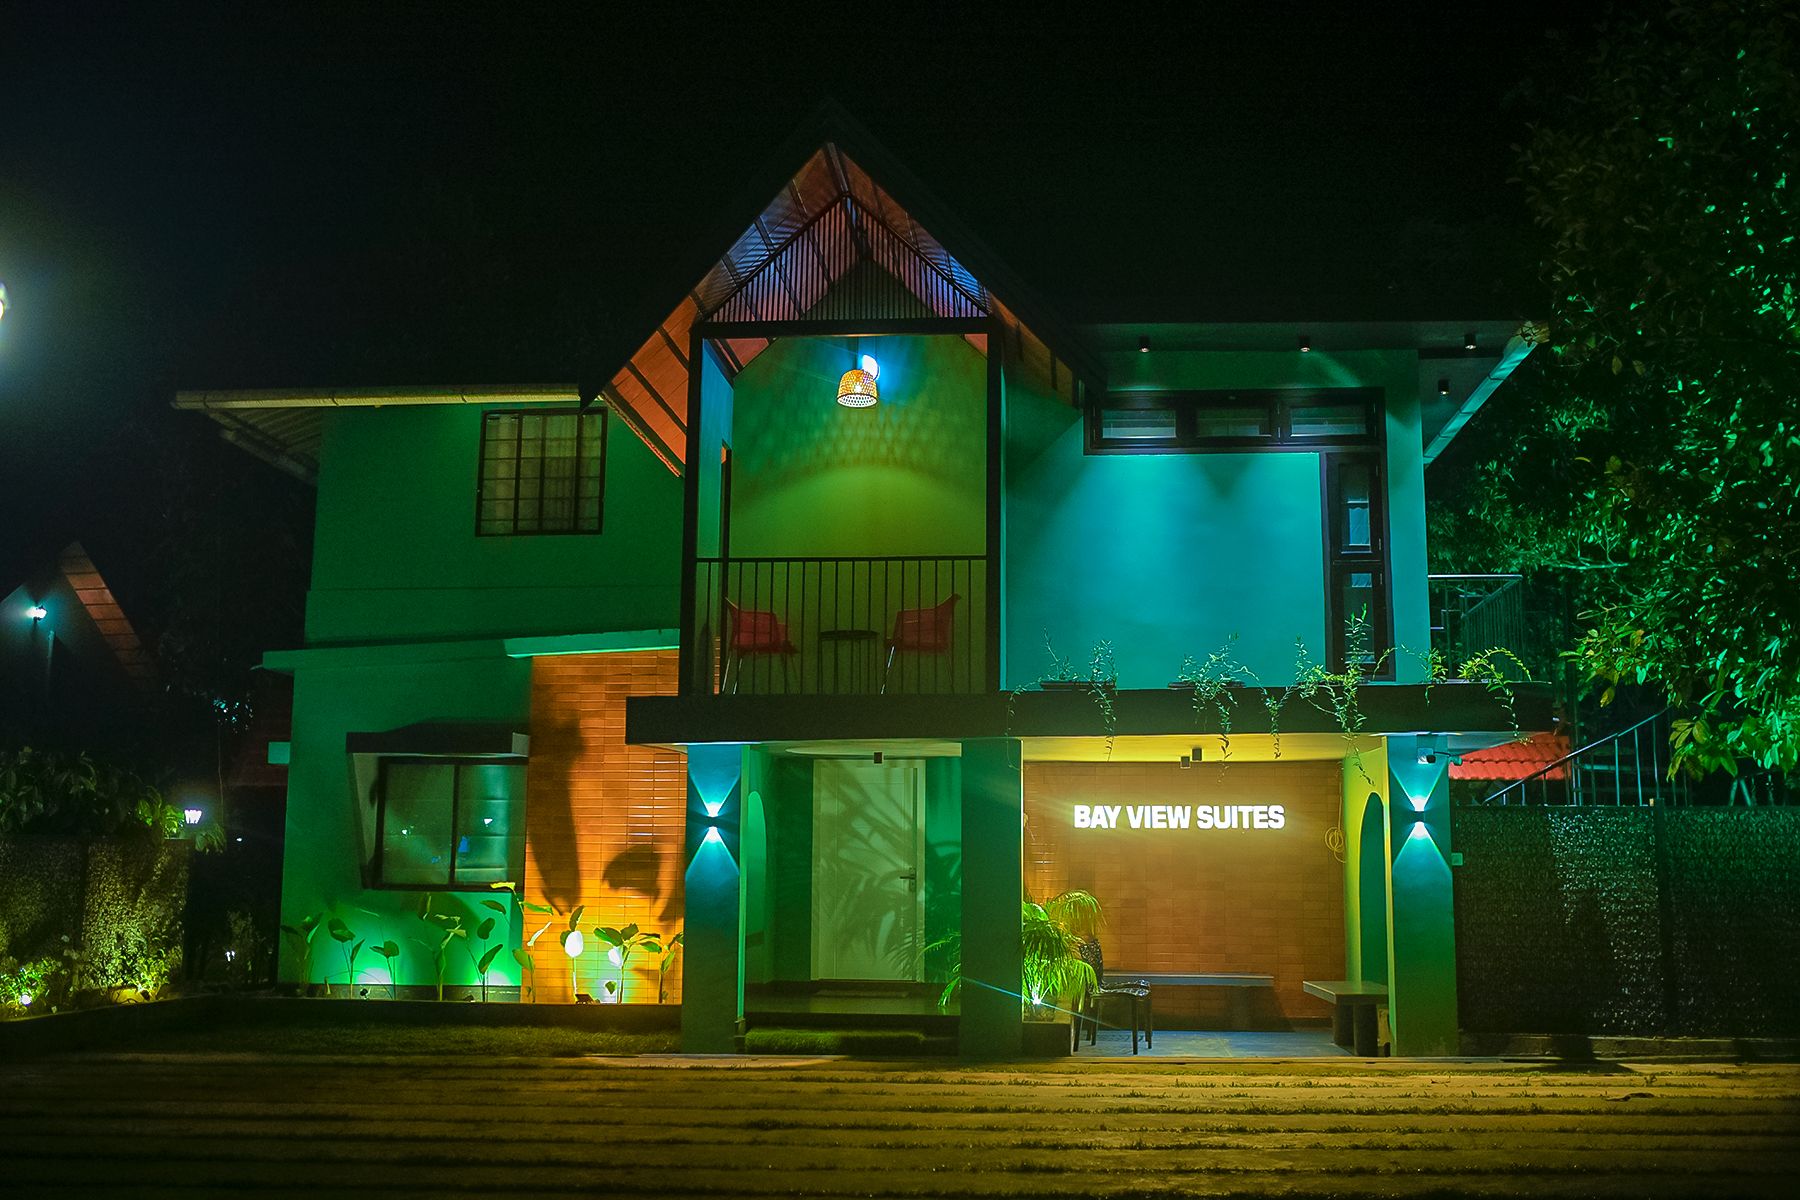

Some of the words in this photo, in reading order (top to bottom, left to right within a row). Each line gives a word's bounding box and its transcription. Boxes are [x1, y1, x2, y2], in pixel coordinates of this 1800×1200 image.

[1073, 804, 1122, 829] BAY
[1126, 804, 1192, 829] VIEW
[1196, 804, 1286, 829] SUITES
